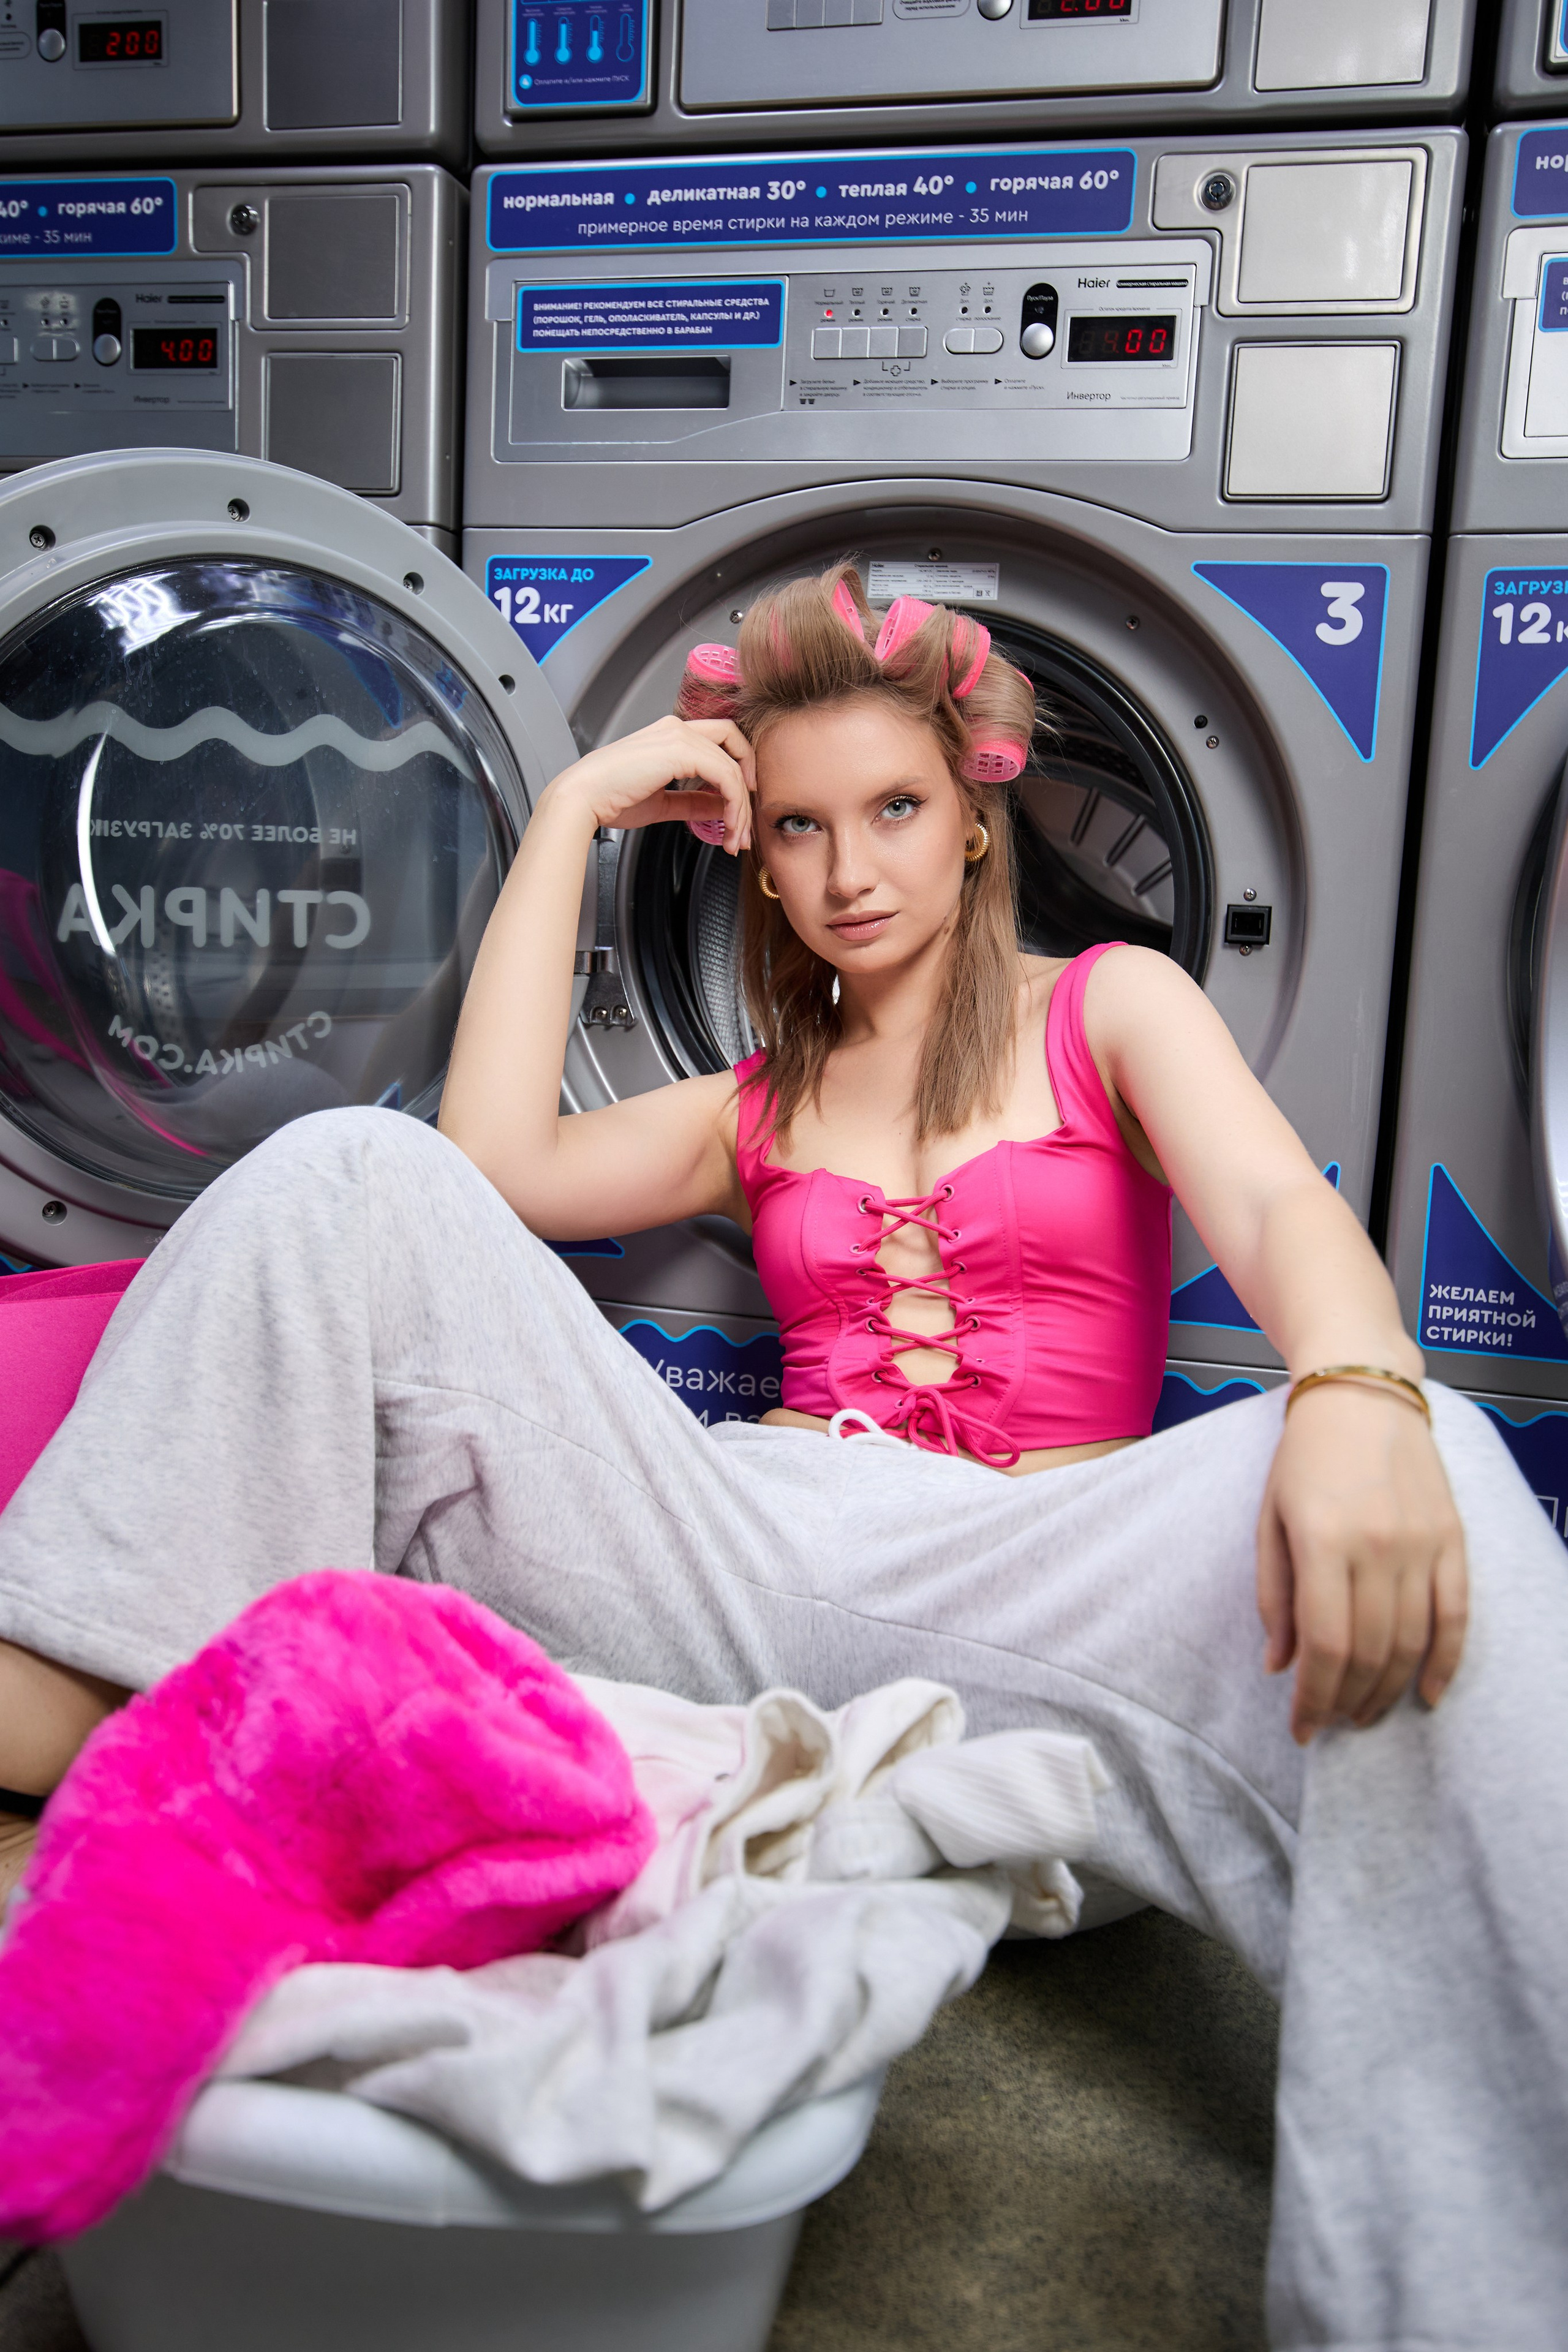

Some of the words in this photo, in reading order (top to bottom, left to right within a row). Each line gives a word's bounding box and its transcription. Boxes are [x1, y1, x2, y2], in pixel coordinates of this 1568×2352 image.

[503, 192, 614, 211] нормальная
[647, 186, 760, 205] деликатная
[767, 180, 807, 200] 30°
[839, 183, 907, 198] теплая
[913, 175, 954, 195] 40°
[990, 175, 1073, 194] горячая
[1079, 170, 1119, 190] 60°
[58, 202, 126, 219] горячая
[130, 197, 163, 214] 60°
[578, 221, 668, 237] примерное
[674, 219, 723, 234] время
[728, 217, 785, 232] стирки
[791, 216, 809, 228] на
[815, 214, 879, 229] каждом
[885, 212, 953, 228] режиме
[969, 208, 989, 223] 35
[995, 210, 1028, 222] мин
[43, 230, 60, 243] 35
[64, 232, 92, 243] мин
[1078, 277, 1110, 288] Haier
[135, 293, 162, 303] Haier
[533, 303, 582, 311] ВНИМАНИЕ!
[584, 301, 646, 310] РЕКОМЕНДУЕМ
[665, 299, 723, 307] СТИРАЛЬНЫЕ
[724, 298, 770, 307] СРЕДСТВА
[533, 315, 583, 325] (ПОРОШОК,
[584, 315, 607, 324] ГЕЛЬ,
[608, 313, 689, 323] ОПОЛАСКИВАТЕЛЬ,
[690, 312, 733, 320] КАПСУЛЫ
[533, 328, 580, 337] ПОМЕЩАТЬ
[581, 327, 666, 337] НЕПОСРЕДСТВЕННО
[674, 326, 713, 334] БАРАБАН
[1066, 391, 1111, 402] Инвертор
[494, 568, 568, 581] ЗАГРУЗКА
[570, 568, 594, 582] ДО
[1494, 581, 1568, 595] ЗАГРУЗ
[1316, 582, 1365, 646] 3
[1429, 1284, 1515, 1305] ЖЕЛАЕМ
[1428, 1305, 1536, 1329] ПРИЯТНОЙ
[1427, 1325, 1512, 1347] СТИРКИ!
